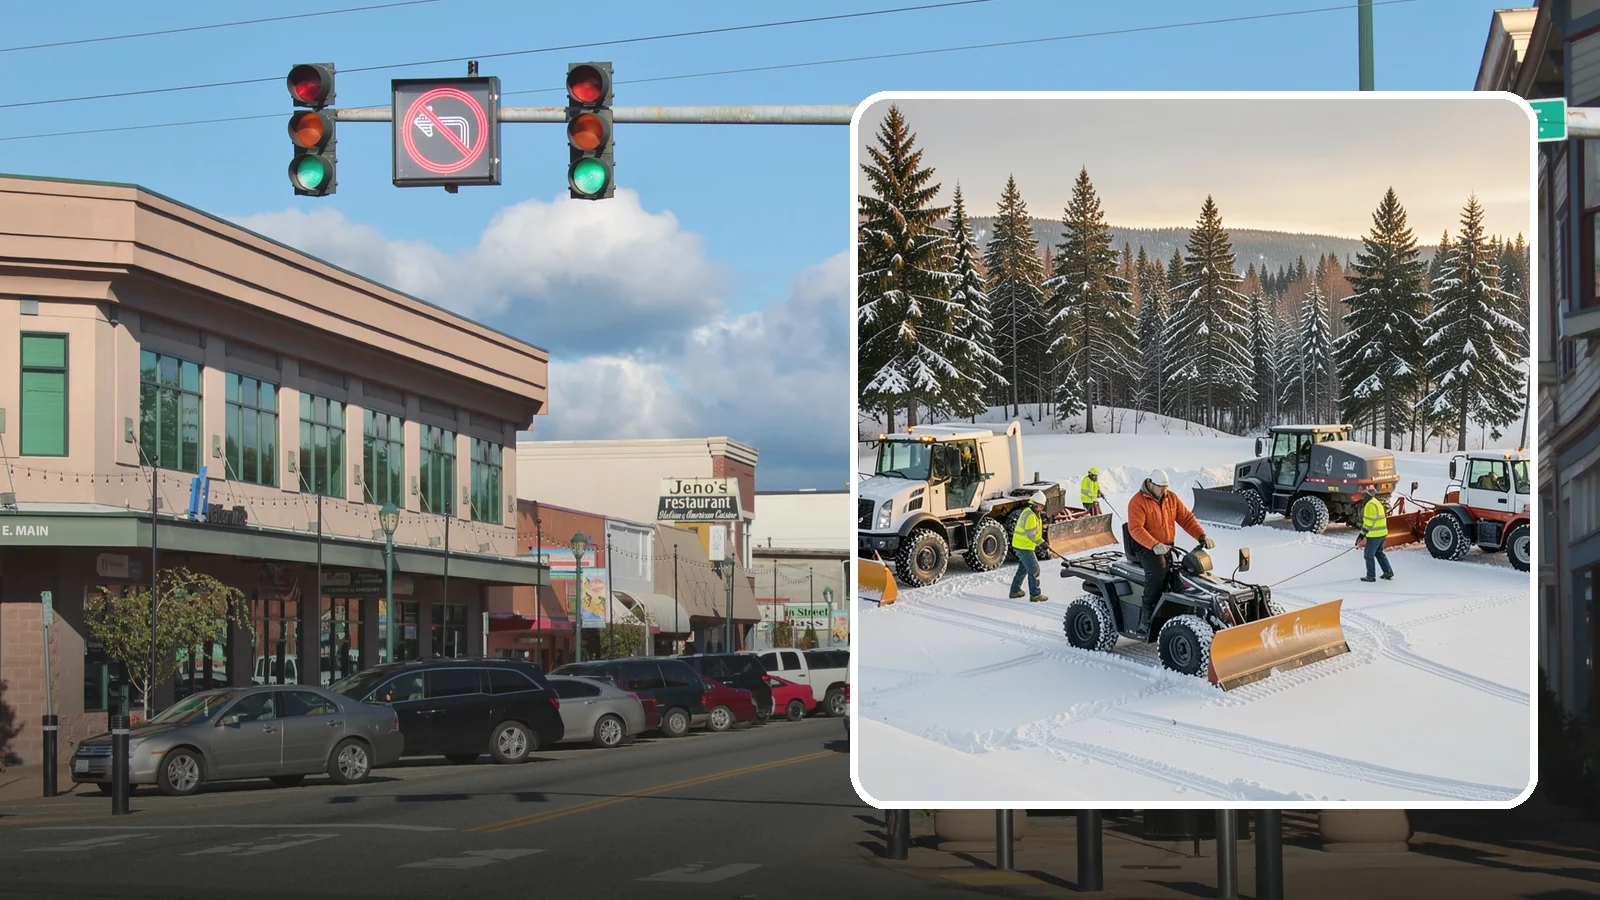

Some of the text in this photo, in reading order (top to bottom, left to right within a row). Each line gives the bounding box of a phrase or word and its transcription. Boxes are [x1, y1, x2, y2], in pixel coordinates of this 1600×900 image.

[670, 480, 727, 494] Jeno's
[665, 497, 730, 508] restaurant
[659, 510, 681, 519] Italian
[686, 510, 714, 519] American
[715, 510, 736, 519] Cuisine
[2, 525, 49, 536] E. MAIN
[798, 607, 828, 616] Street
